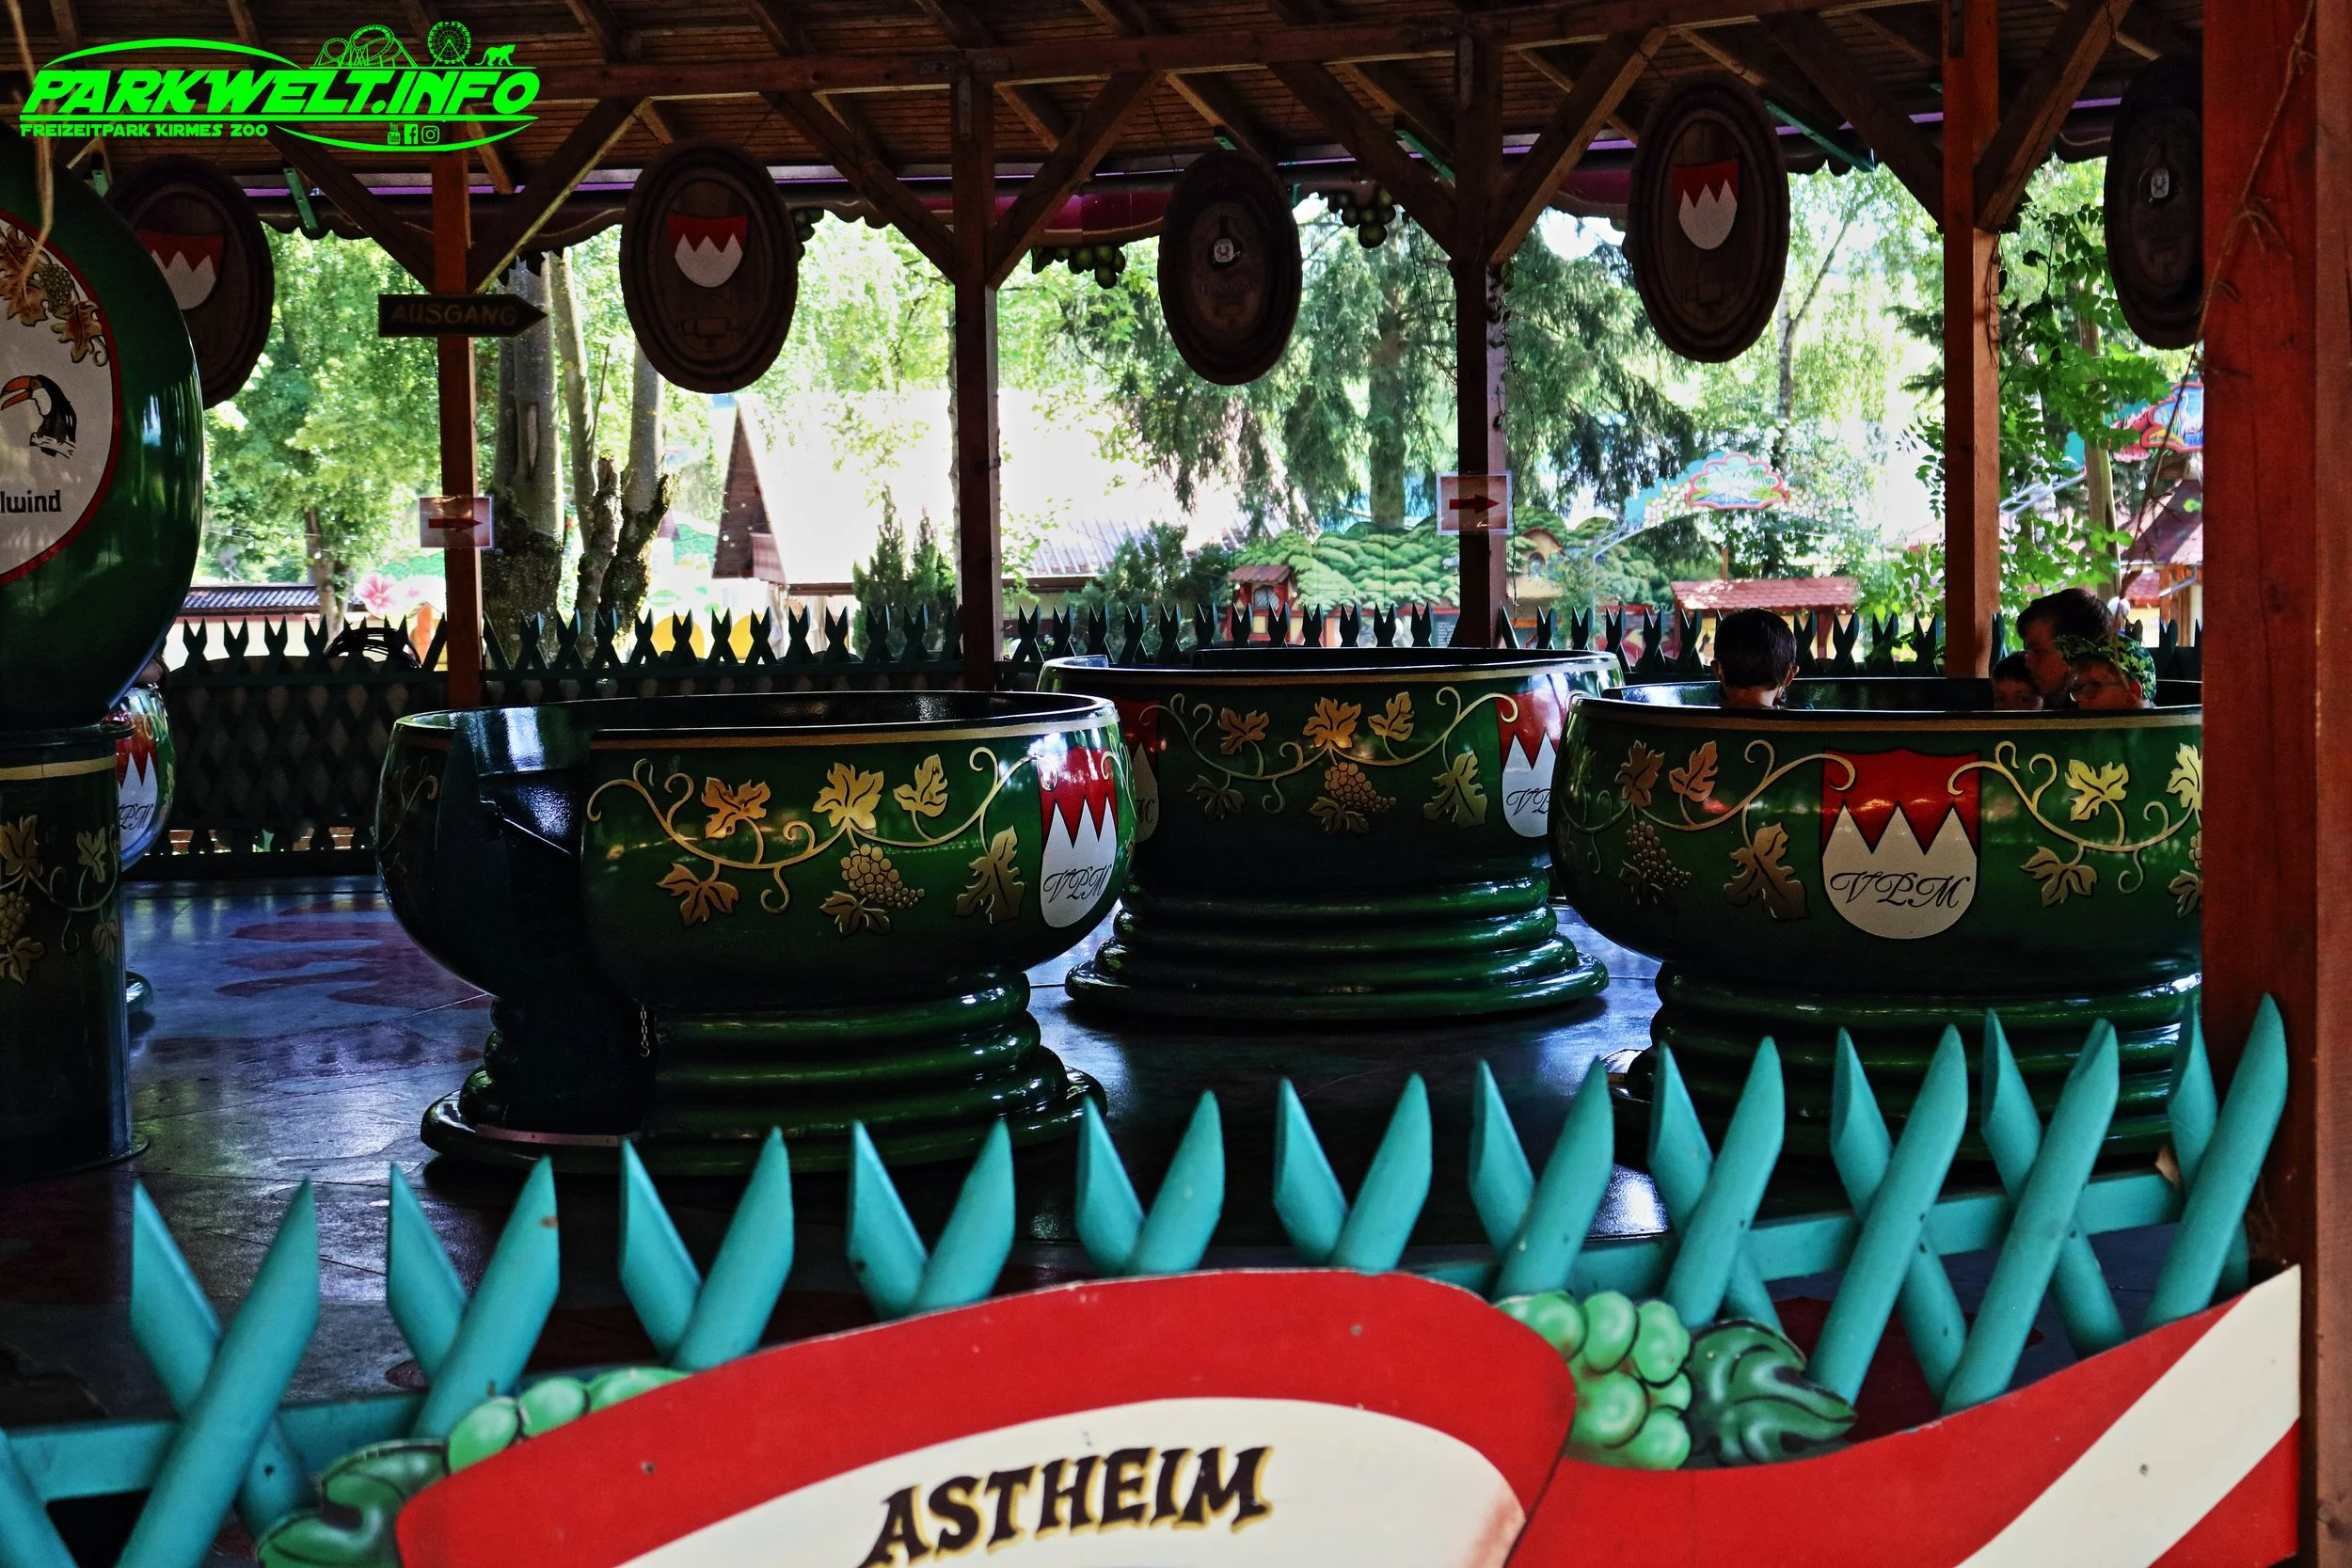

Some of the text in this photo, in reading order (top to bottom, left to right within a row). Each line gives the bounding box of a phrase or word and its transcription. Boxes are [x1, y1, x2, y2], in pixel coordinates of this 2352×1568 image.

[390, 303, 516, 326] AUSGANG
[1506, 787, 1550, 816] VP
[855, 1445, 1274, 1568] ASTHEIM
